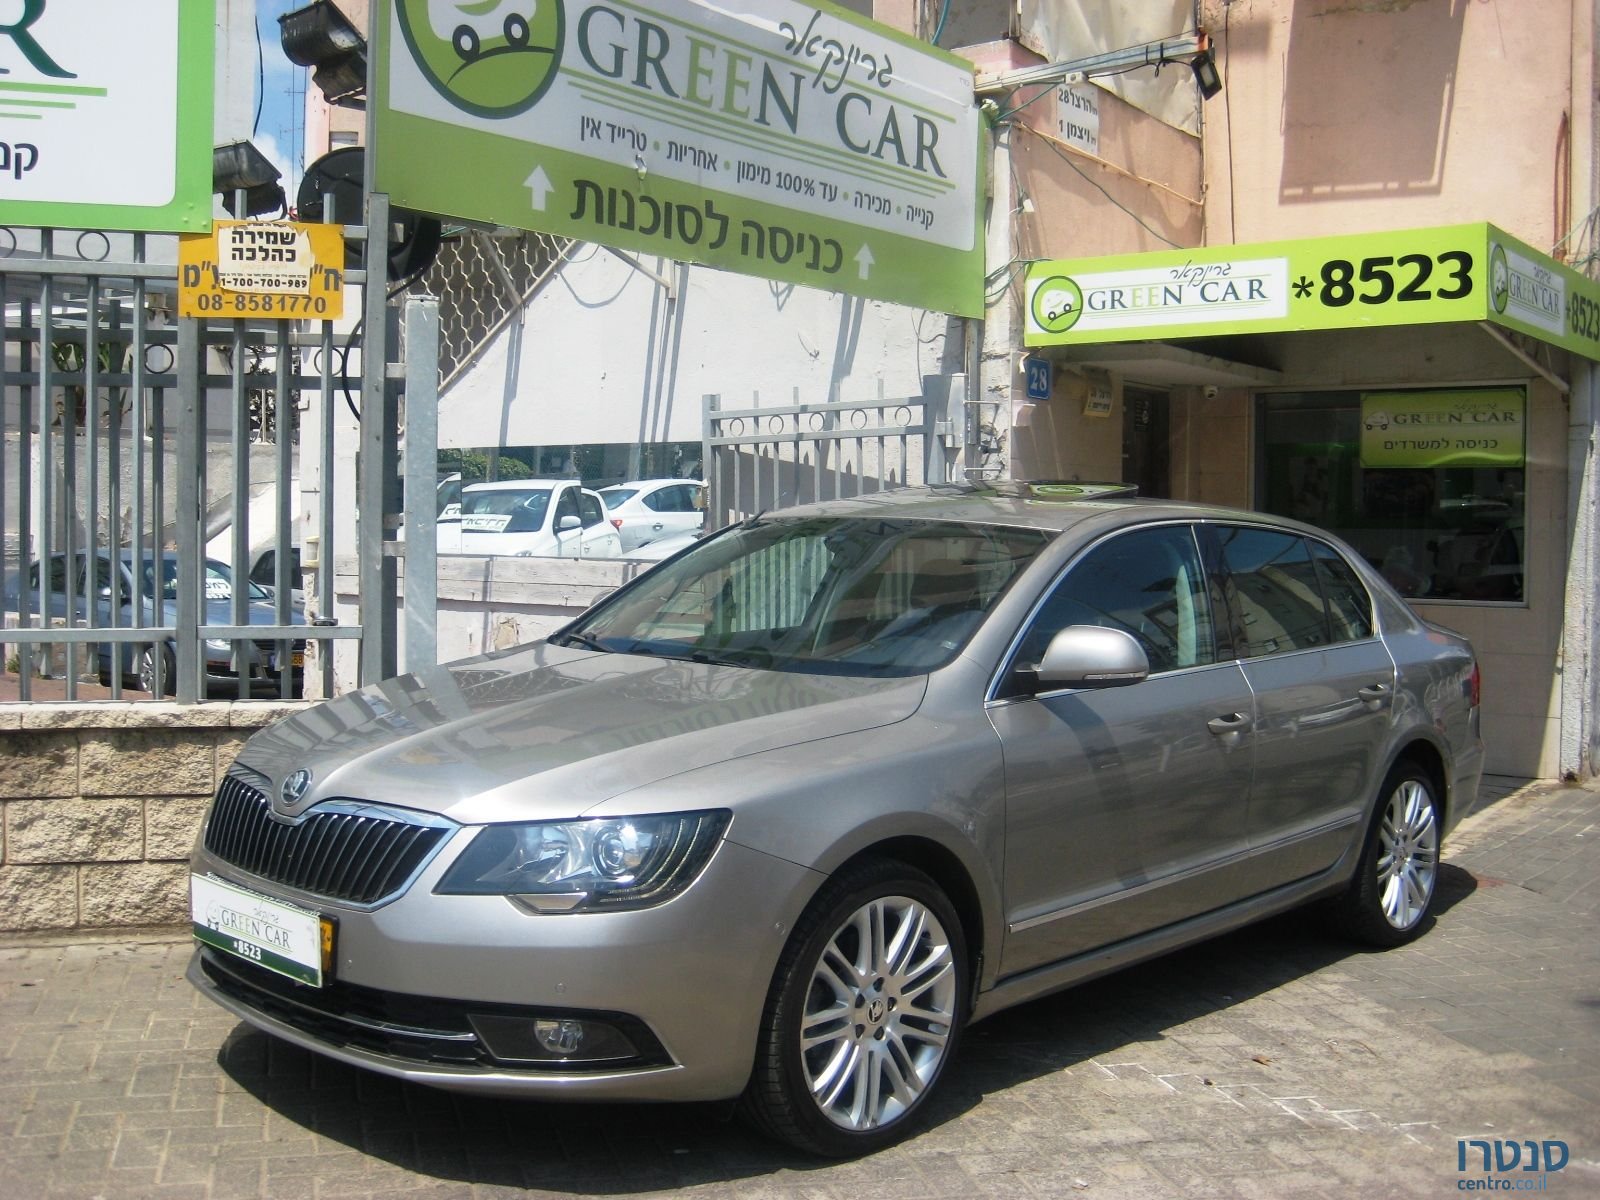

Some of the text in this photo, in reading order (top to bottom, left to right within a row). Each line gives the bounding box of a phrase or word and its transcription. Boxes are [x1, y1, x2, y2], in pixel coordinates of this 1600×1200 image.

[778, 9, 893, 94] גרינקאר
[577, 5, 947, 178] GREEN CAR
[1058, 88, 1070, 104] 28
[1070, 89, 1092, 113] הרצל
[1058, 119, 1064, 133] 1
[1067, 122, 1090, 143] ויצמן
[580, 115, 934, 231] קנייה מכירה עד 100% מימון אחריות טרייד אין
[231, 230, 296, 246] שמירה
[570, 179, 844, 275] כניסה לסוכנות
[231, 245, 296, 263] כהלכה
[221, 277, 308, 288] 1-700-700-989
[1169, 259, 1232, 287] גרינקאר
[197, 293, 327, 314] 08-8581770
[1087, 278, 1268, 311] GREEN CAR
[1509, 272, 1539, 305] GREEN
[1542, 287, 1560, 315] CAR
[1029, 366, 1048, 392] 28
[1393, 411, 1516, 425] GREEN CAR
[1383, 437, 1499, 450] כניסה למשרדים
[221, 909, 261, 936] GREEN
[264, 927, 291, 949] CAR
